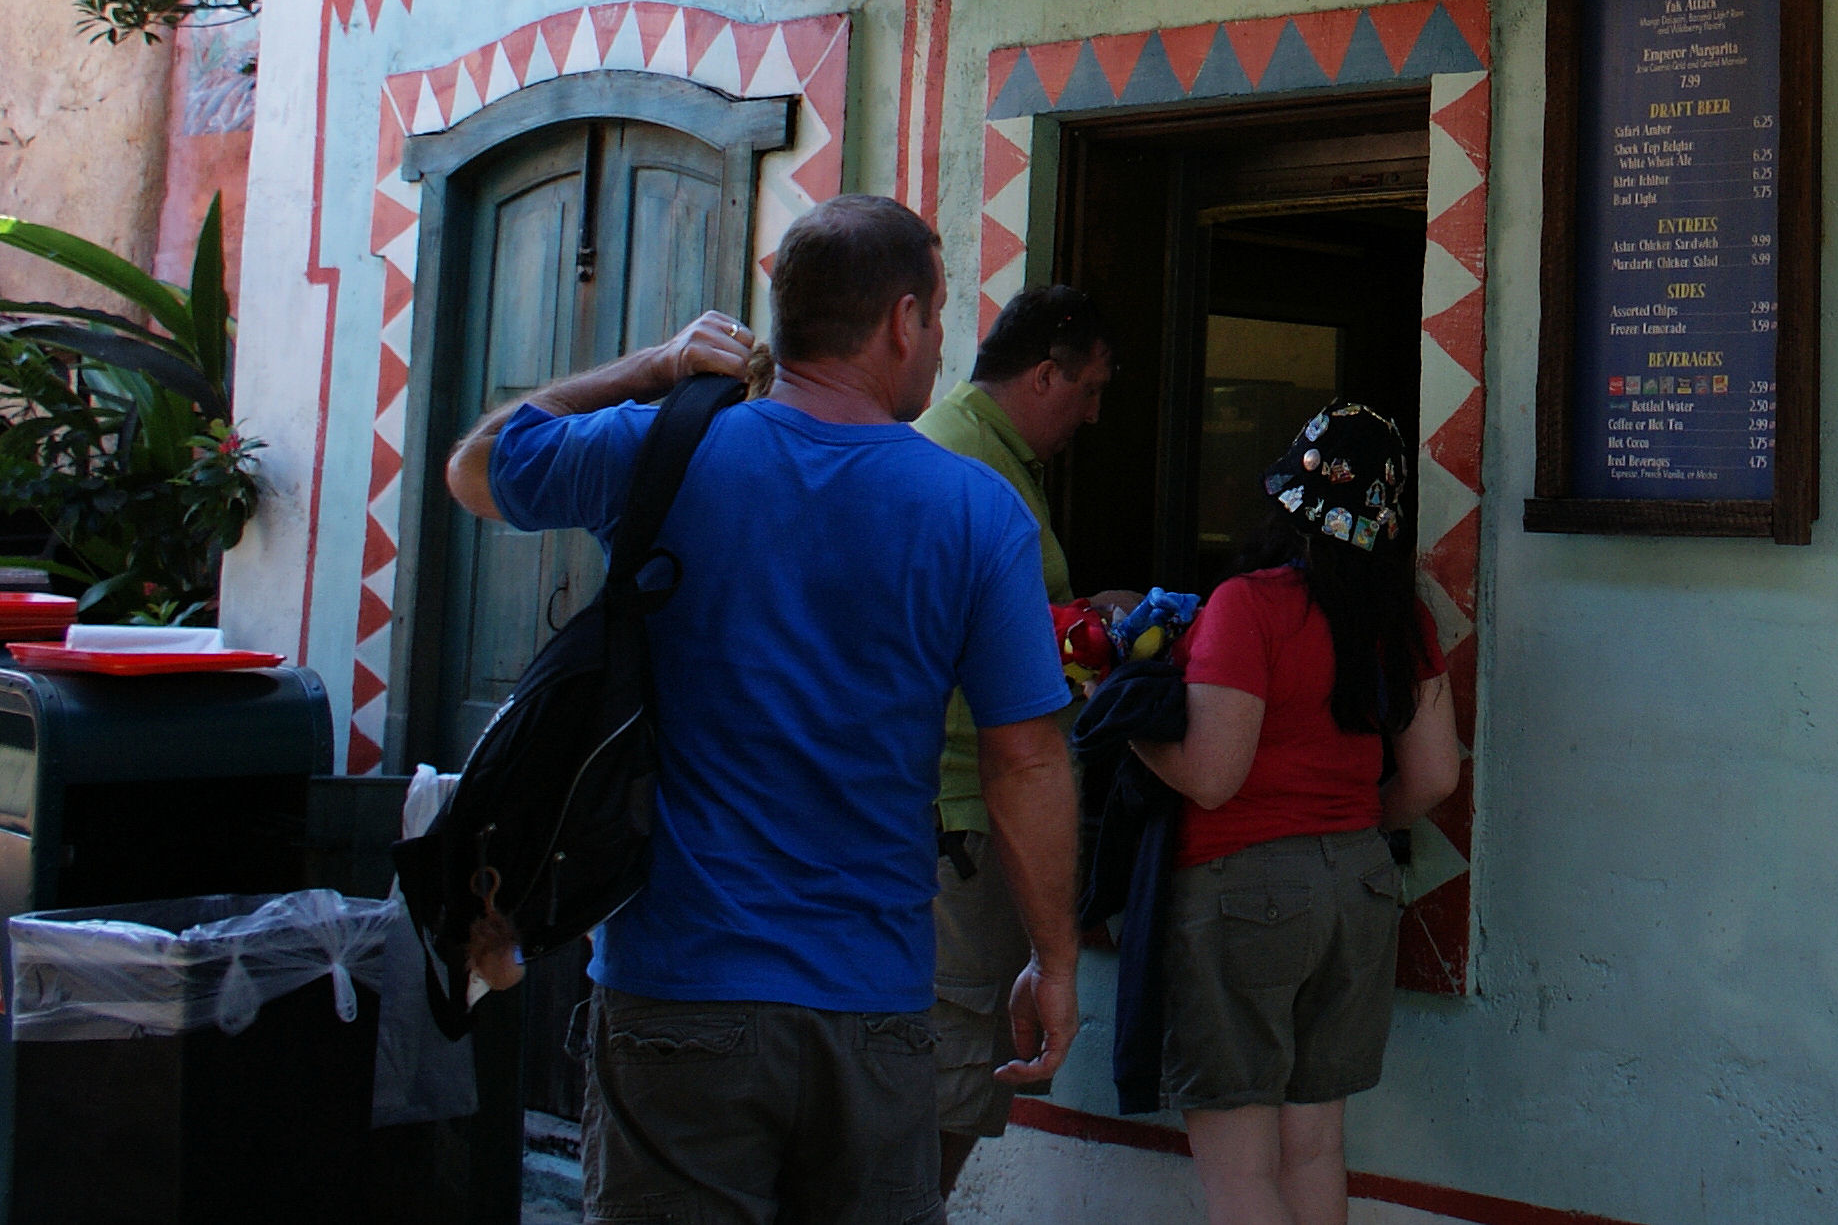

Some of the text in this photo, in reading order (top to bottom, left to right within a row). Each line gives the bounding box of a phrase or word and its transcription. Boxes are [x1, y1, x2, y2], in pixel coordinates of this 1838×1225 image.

[1665, 0, 1681, 13] Yak
[1643, 42, 1739, 63] Emperor Margarita
[1680, 75, 1700, 89] 7.99
[1650, 98, 1731, 119] DRAFT BEER
[1614, 115, 1773, 138] Safari Amber 6.25
[1643, 142, 1660, 156] Top
[1619, 149, 1773, 170] White Wheat Ale 6.25
[1753, 167, 1773, 180] 6.25
[1613, 185, 1773, 207] Bud Light 5.75
[1657, 216, 1718, 234] ENTREES
[1612, 235, 1771, 253] Asian Chicken Sandwich 9.99
[1612, 258, 1653, 271] Mandarin
[1657, 257, 1689, 269] Chicken
[1693, 254, 1719, 267] Salad
[1667, 283, 1706, 299] SIDES
[1610, 301, 1770, 319] Assorted Chips 2.99
[1610, 323, 1639, 336] Frozen
[1642, 322, 1687, 335] Lemonade
[1648, 351, 1724, 367] BEVERAGES
[1632, 400, 1664, 413] Bottled
[1667, 401, 1695, 413] Water
[1750, 399, 1768, 412] 2.50
[1607, 418, 1768, 431] Coffee or Hot Tea 2.99
[1608, 437, 1768, 450] Hot Cocoa 3.75
[1607, 454, 1767, 469] Iced Beverages 4.75
